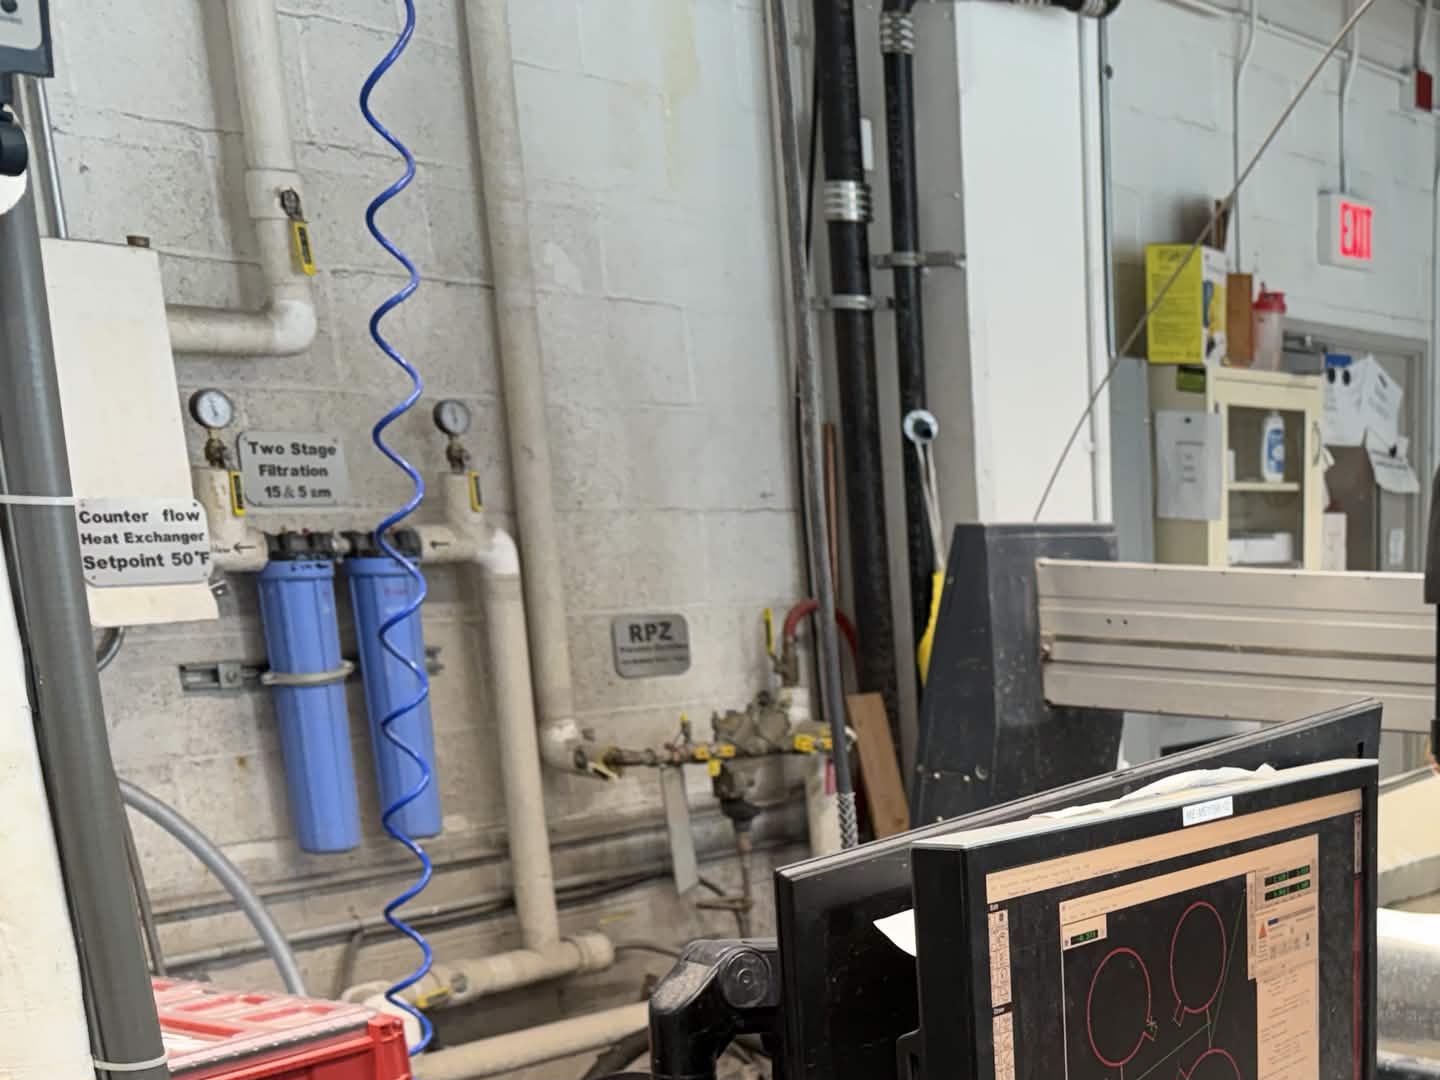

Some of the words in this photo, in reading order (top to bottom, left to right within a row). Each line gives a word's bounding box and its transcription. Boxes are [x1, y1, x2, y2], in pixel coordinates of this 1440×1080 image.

[1340, 202, 1373, 262] EXIT
[247, 441, 285, 455] Two
[290, 442, 337, 458] Stage
[258, 464, 329, 477] Filtration
[265, 485, 281, 498] 15
[298, 485, 307, 498] 5
[79, 510, 149, 524] Counter
[162, 509, 200, 522] flow
[80, 533, 119, 545] Heat
[123, 531, 205, 545] Exchanger
[83, 553, 165, 572] Setpoint
[171, 551, 210, 567] 50°F
[628, 621, 674, 643] RPZ
